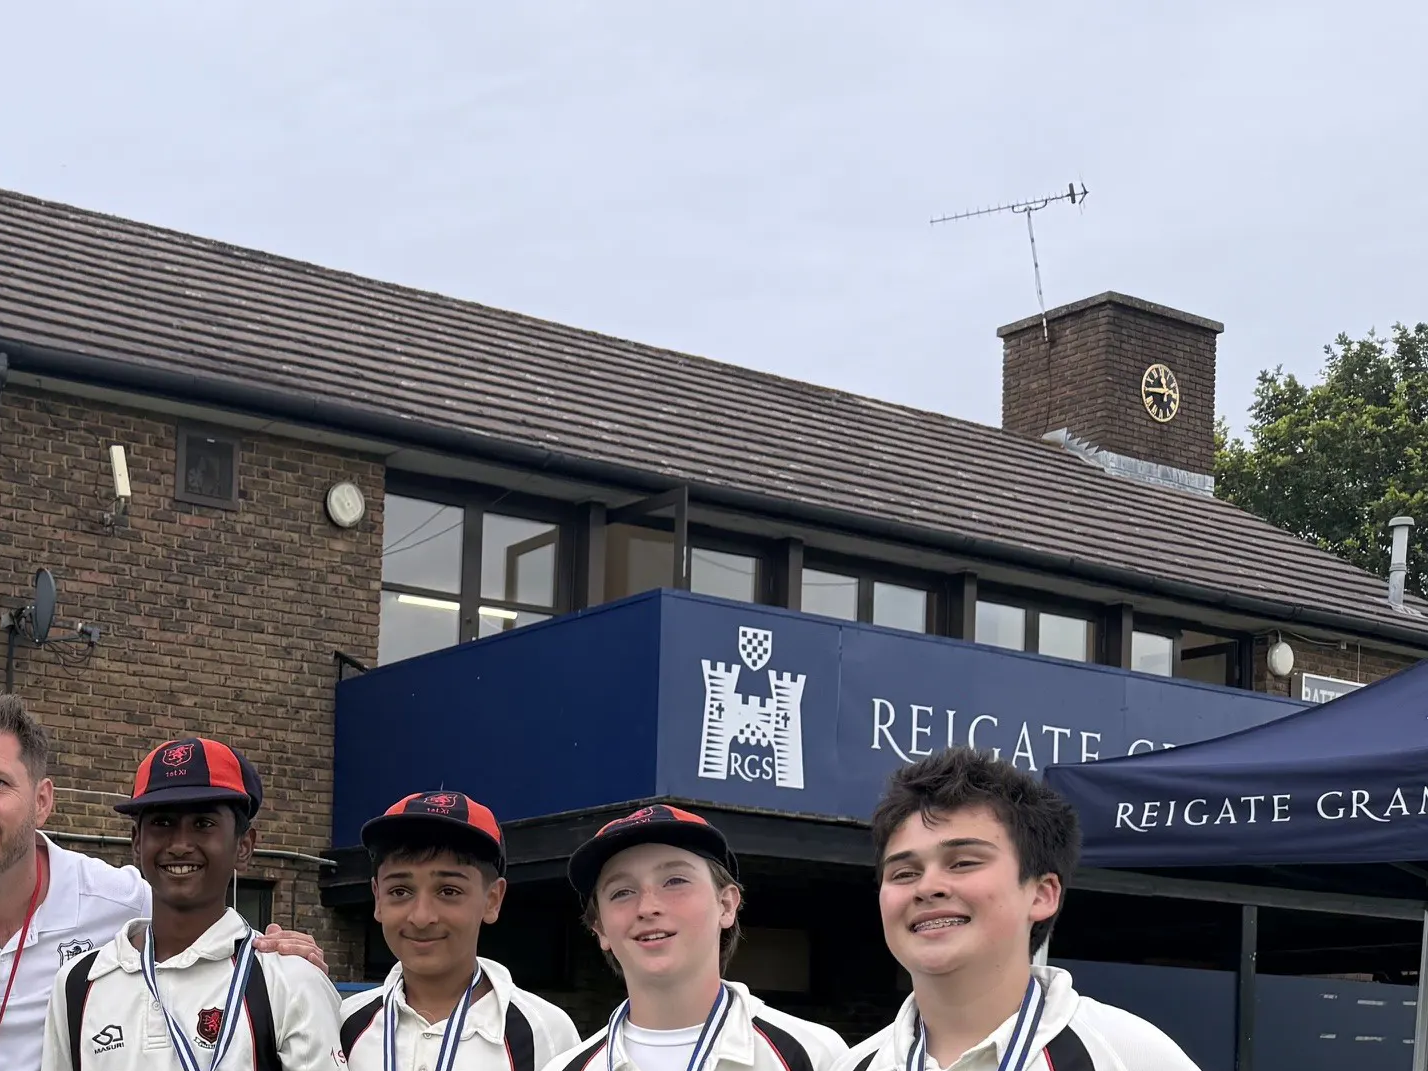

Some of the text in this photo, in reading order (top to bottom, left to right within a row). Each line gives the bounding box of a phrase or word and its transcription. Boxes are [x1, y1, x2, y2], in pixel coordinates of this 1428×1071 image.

[870, 698, 1101, 772] REIGATE
[730, 752, 773, 782] RGS
[1114, 786, 1428, 832] REIGATE GRA
[94, 1041, 125, 1055] MASURI
